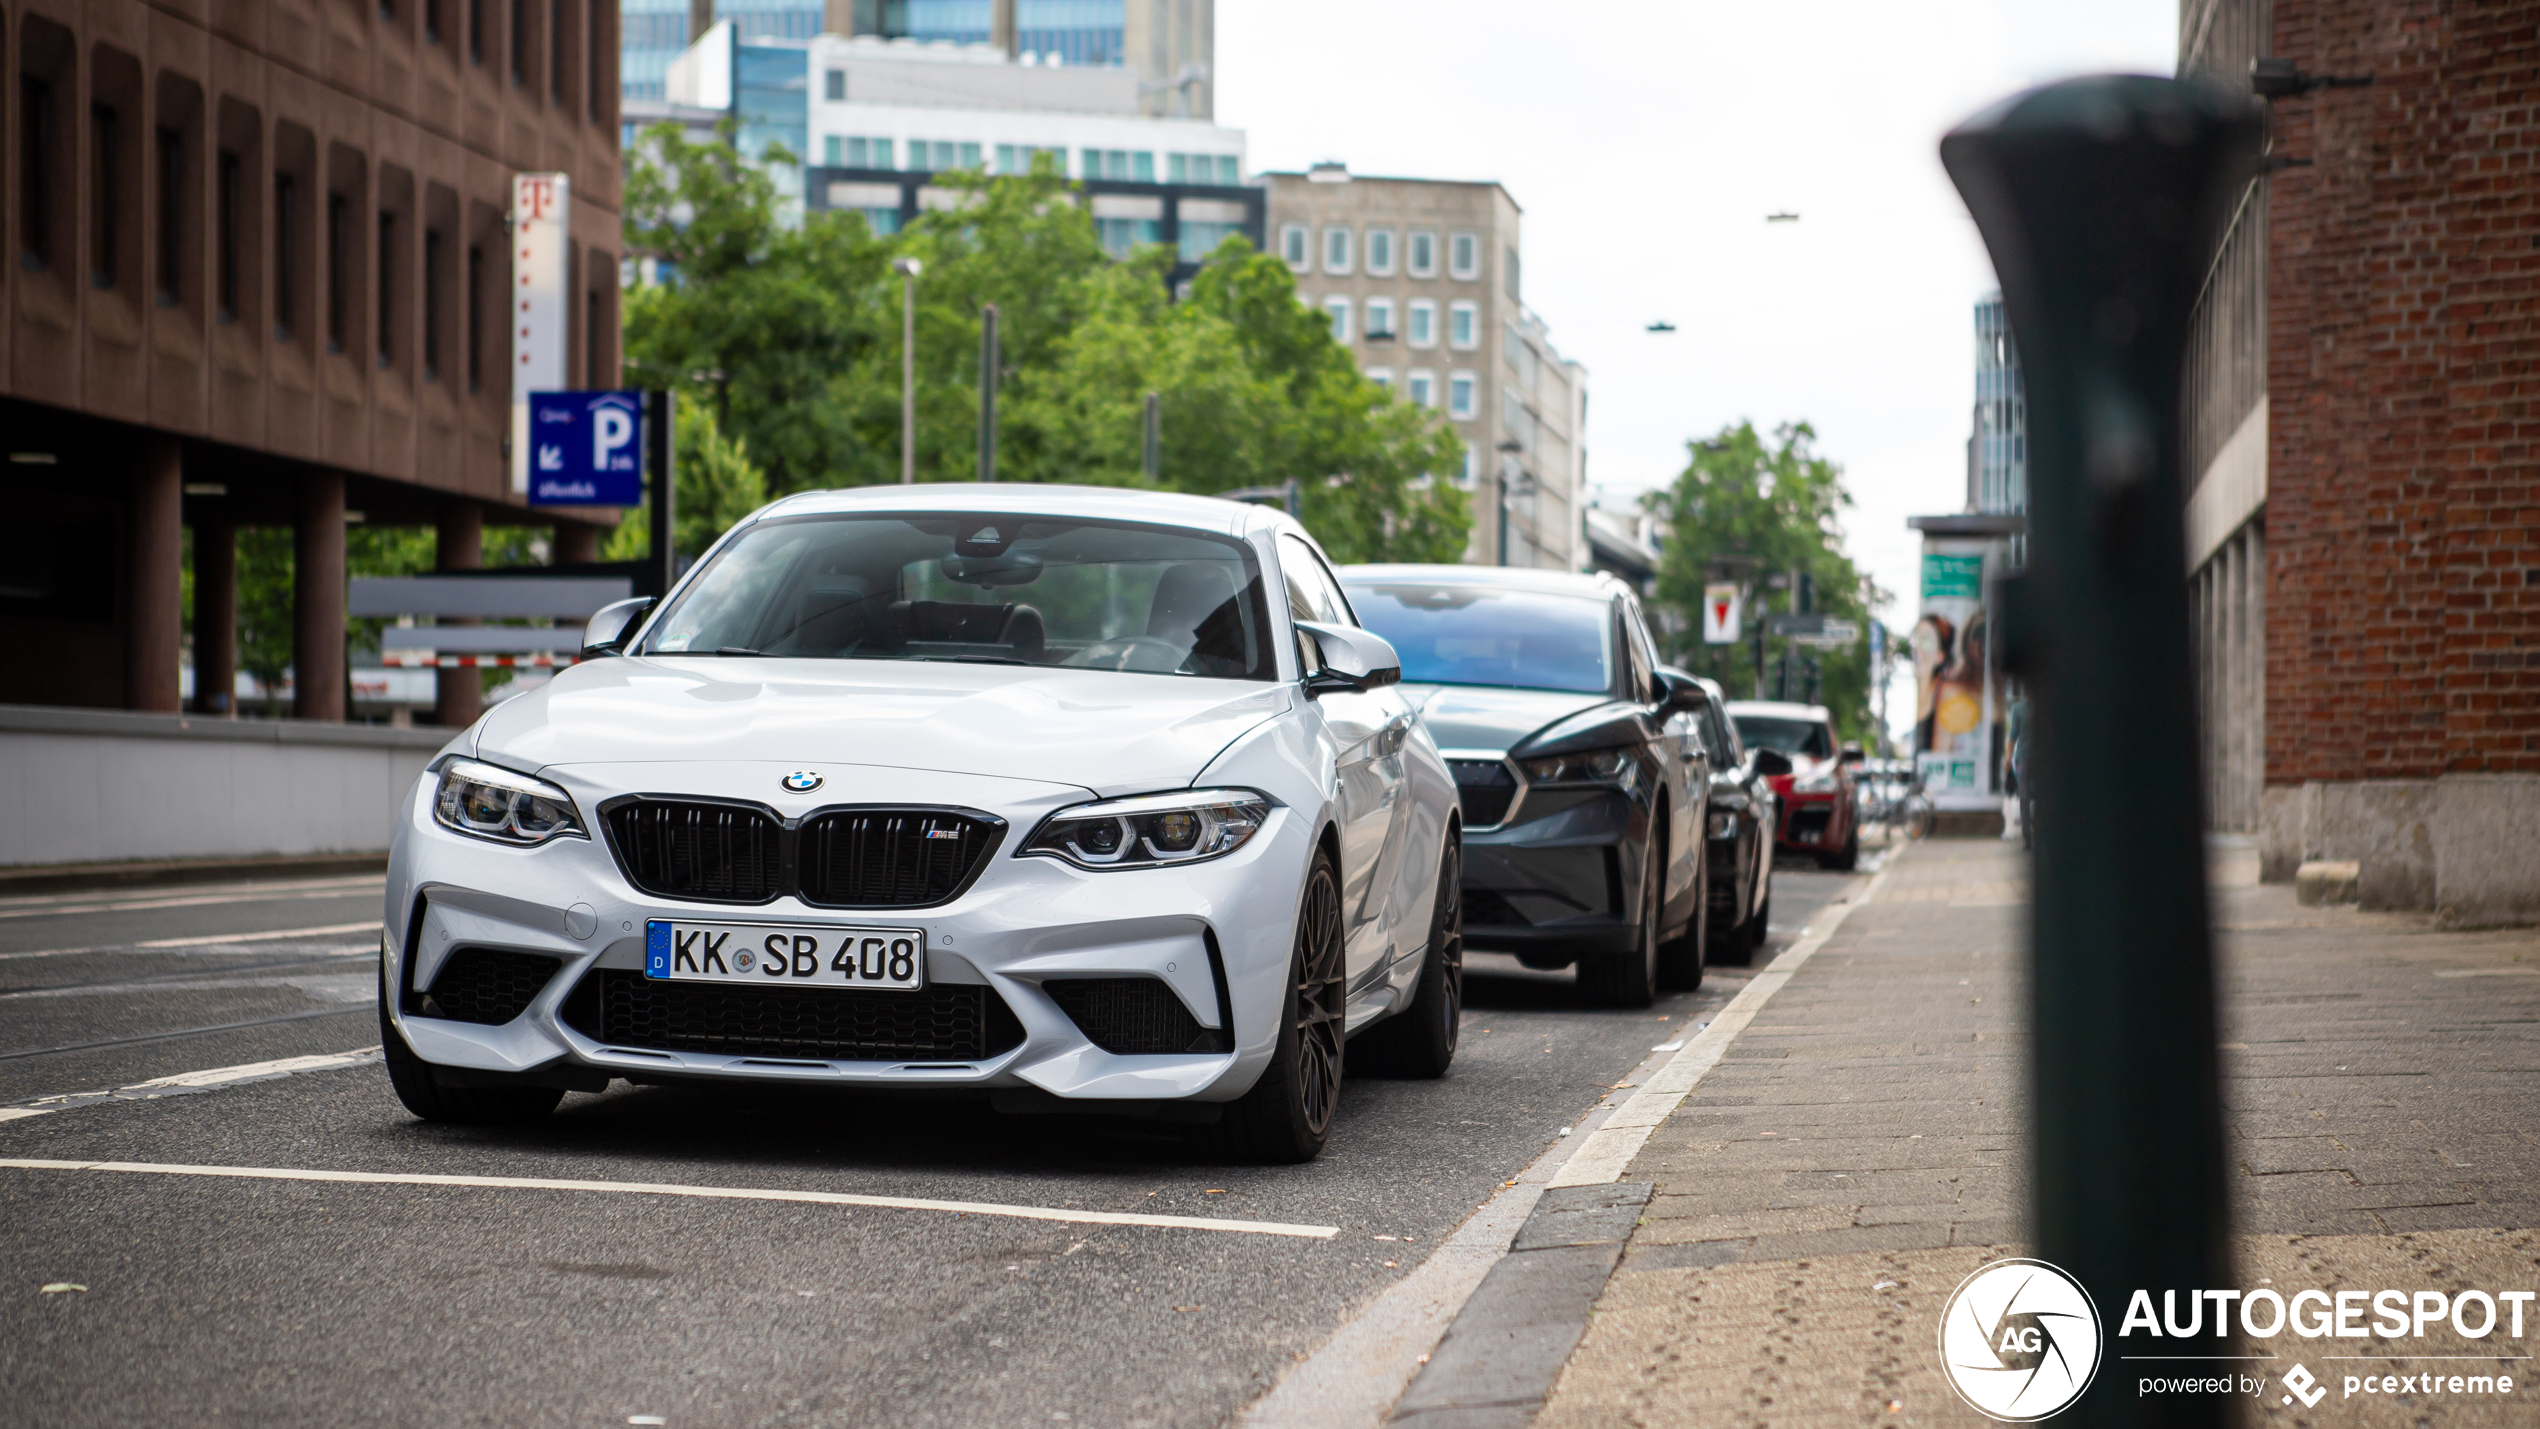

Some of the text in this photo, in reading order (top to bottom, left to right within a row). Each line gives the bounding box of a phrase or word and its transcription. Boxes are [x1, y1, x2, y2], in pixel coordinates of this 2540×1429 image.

[593, 407, 633, 471] P
[654, 956, 664, 969] D
[674, 929, 730, 974] KK
[762, 933, 819, 977] SB
[831, 936, 914, 981] 408
